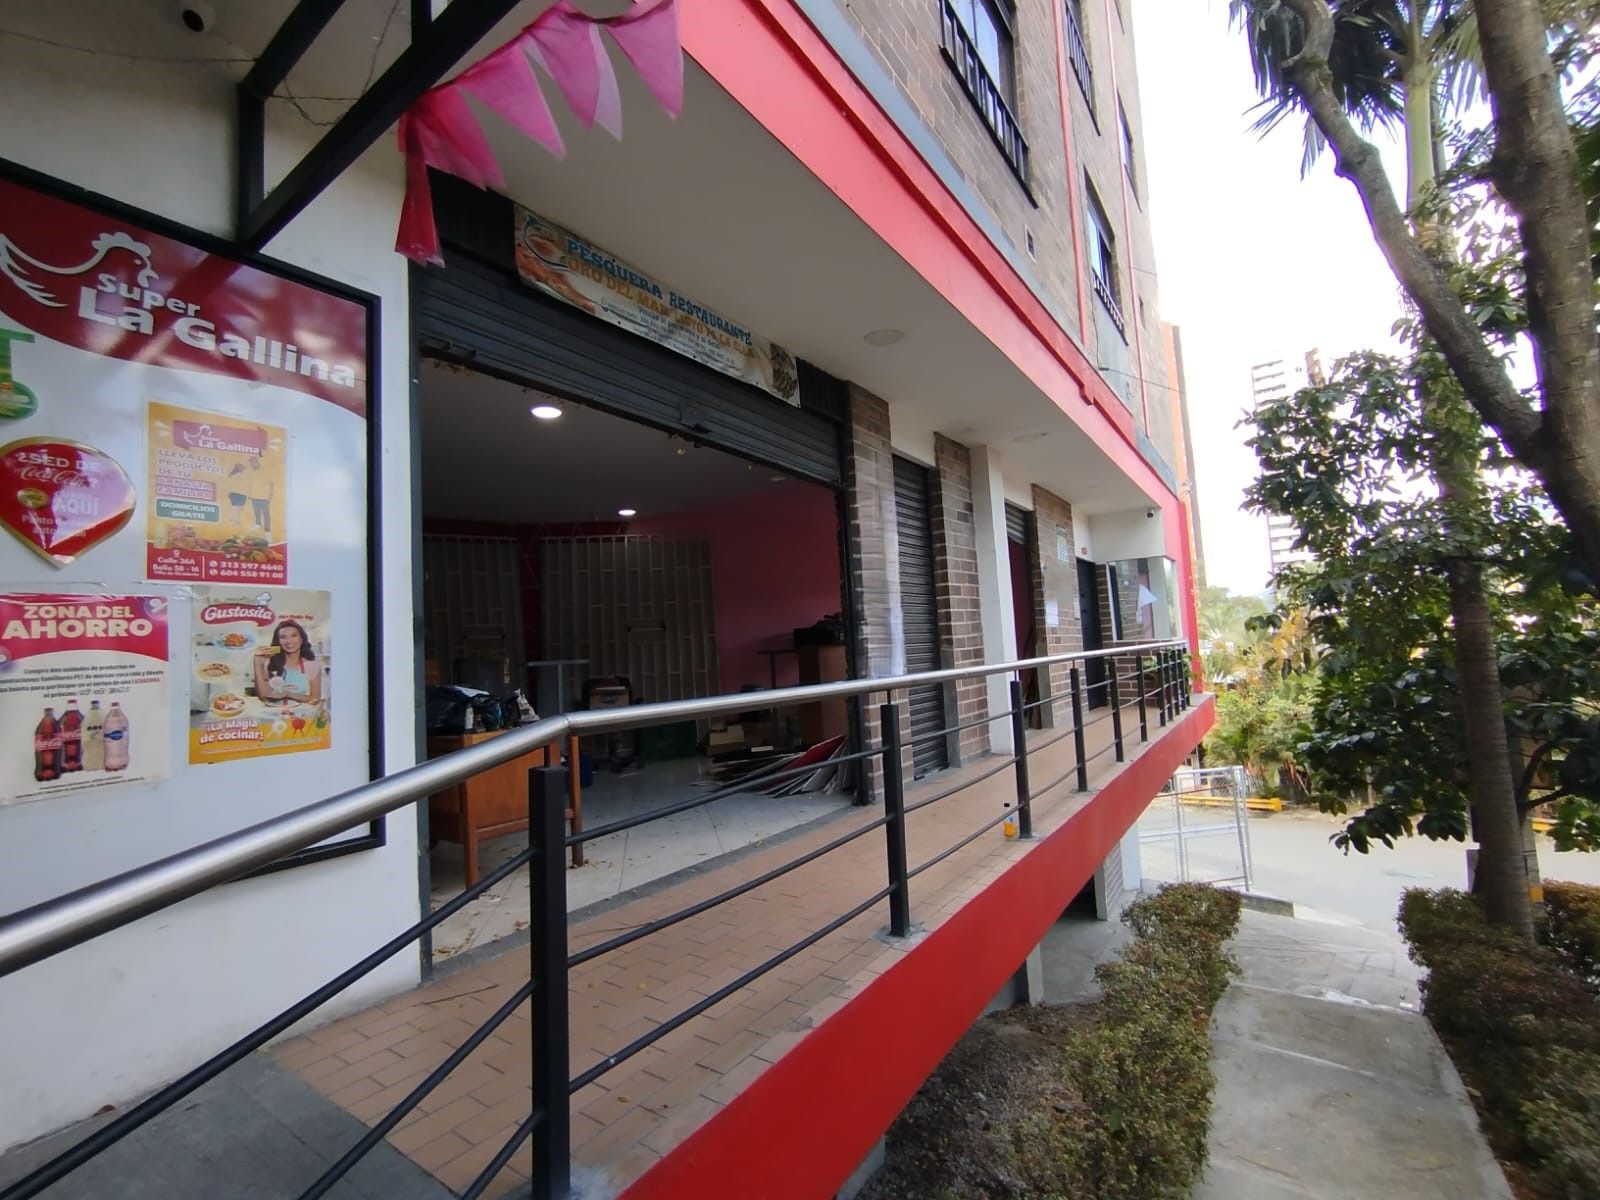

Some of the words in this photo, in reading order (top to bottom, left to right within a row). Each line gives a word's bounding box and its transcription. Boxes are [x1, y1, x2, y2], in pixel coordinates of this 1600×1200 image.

[567, 238, 663, 300] PESQUERA
[669, 291, 753, 346] RESTAURANTE
[568, 257, 602, 283] ORO
[606, 275, 634, 300] DEL
[637, 290, 670, 317] MAR
[97, 273, 201, 318] Super
[78, 286, 154, 335] La
[174, 316, 356, 388] Gallina
[198, 440, 214, 449] La
[217, 442, 260, 454] Gallina
[75, 460, 100, 473] DE
[158, 458, 225, 474] PRODUCTOS
[197, 455, 217, 464] LOS
[158, 468, 171, 476] DE
[177, 470, 192, 478] TU
[158, 478, 213, 491] CANASTA
[157, 487, 213, 500] FAMILIAR
[160, 501, 216, 513] DOMICILIOS
[171, 511, 206, 520] GRATIS
[220, 561, 239, 569] 313
[24, 605, 92, 619] ZONA
[96, 605, 135, 618] DEL
[204, 606, 274, 622] Gustosita
[1, 618, 154, 640] AHORRO
[225, 719, 258, 730] Magia
[200, 733, 215, 744] de
[217, 730, 264, 741] cocinar!
